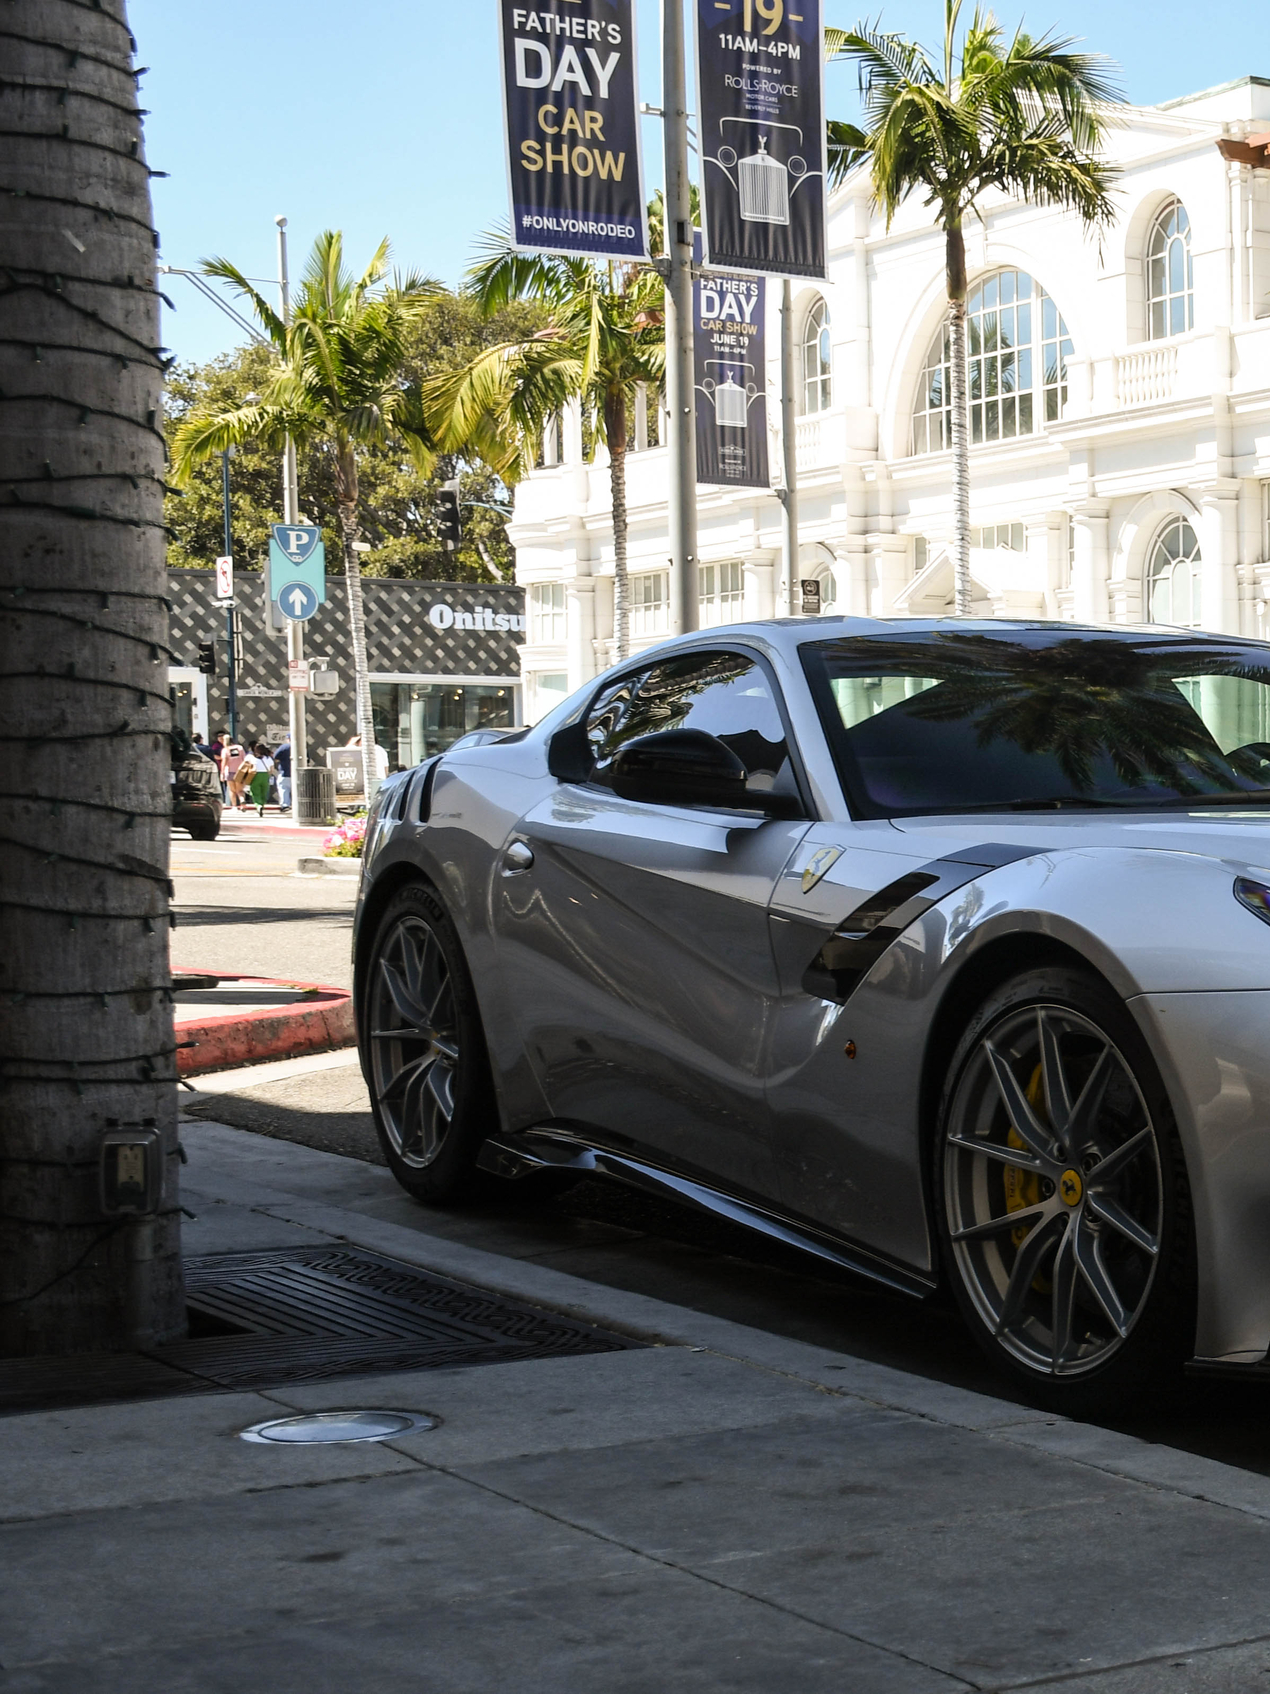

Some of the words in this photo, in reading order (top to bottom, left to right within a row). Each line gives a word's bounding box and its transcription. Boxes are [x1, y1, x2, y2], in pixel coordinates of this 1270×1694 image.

[513, 8, 622, 45] FATHER'S
[514, 37, 621, 99] DAY
[742, 63, 772, 74] POWERED
[773, 67, 782, 75] BY
[724, 74, 799, 98] ROLLS-ROYCE
[538, 104, 606, 141] CAR
[520, 140, 626, 182] SHOW
[522, 215, 636, 239] #ONLYONRODEO
[700, 278, 759, 296] FATHER'S
[701, 289, 758, 323] DAY
[700, 319, 724, 331] CAR
[726, 321, 758, 335] SHOW
[710, 333, 737, 346] JUNE
[739, 336, 750, 347] 19
[286, 530, 310, 553] P
[429, 603, 527, 632] Onitsu
[337, 770, 357, 781] DAY
